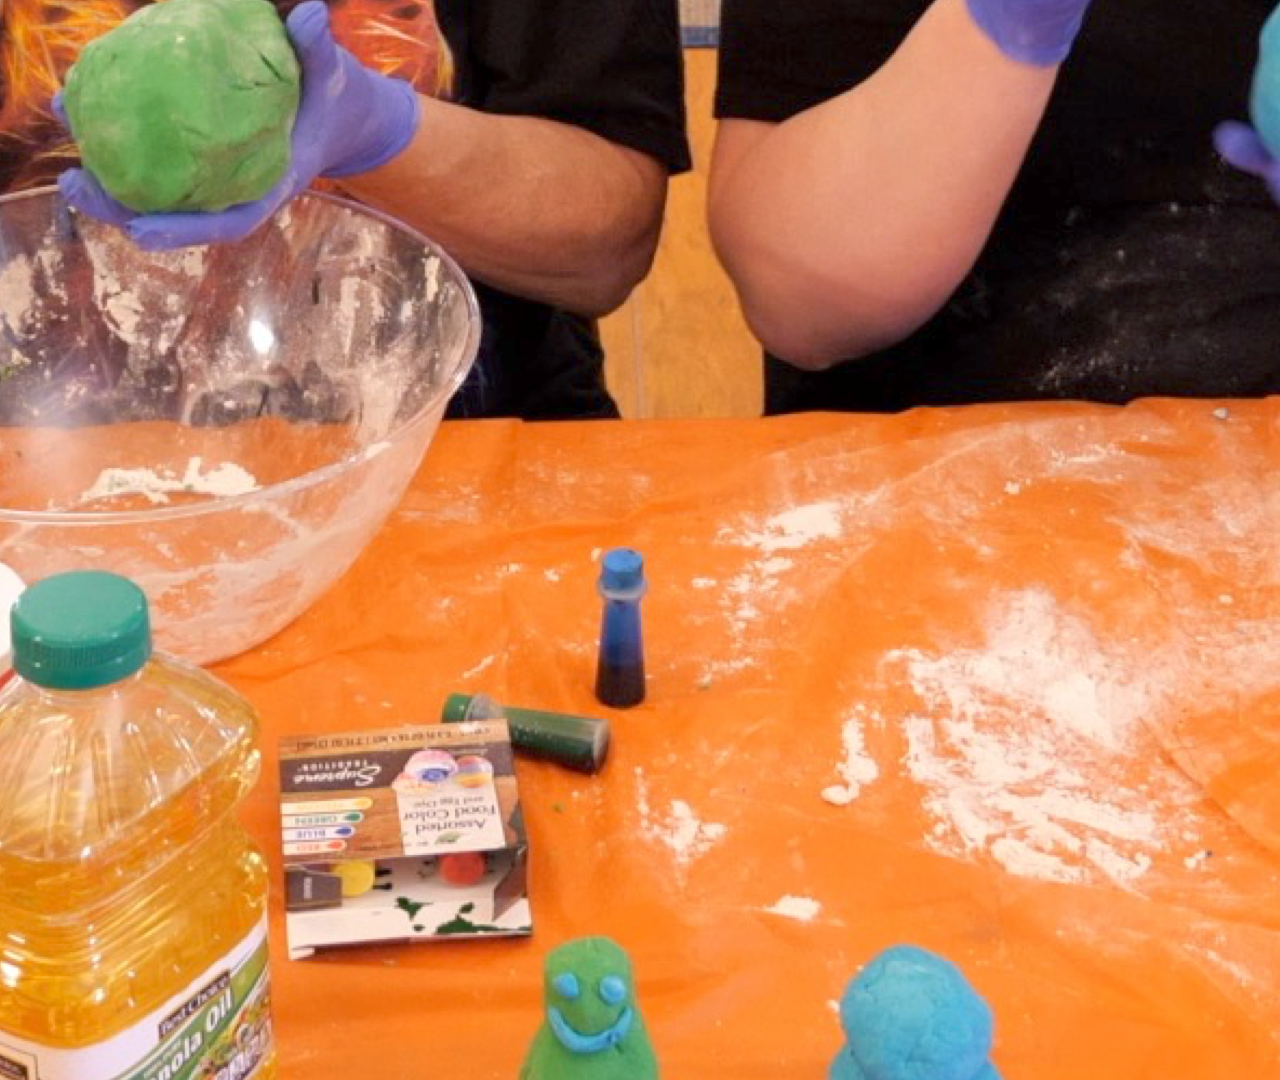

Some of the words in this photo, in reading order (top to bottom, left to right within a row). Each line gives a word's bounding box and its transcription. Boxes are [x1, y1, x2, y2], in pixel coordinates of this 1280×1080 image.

[293, 766, 381, 787] Supreme
[402, 807, 450, 822] Color
[454, 804, 496, 819] Food
[415, 818, 486, 836] Assorted
[150, 1031, 203, 1080] nola
[205, 986, 232, 1033] Oil
